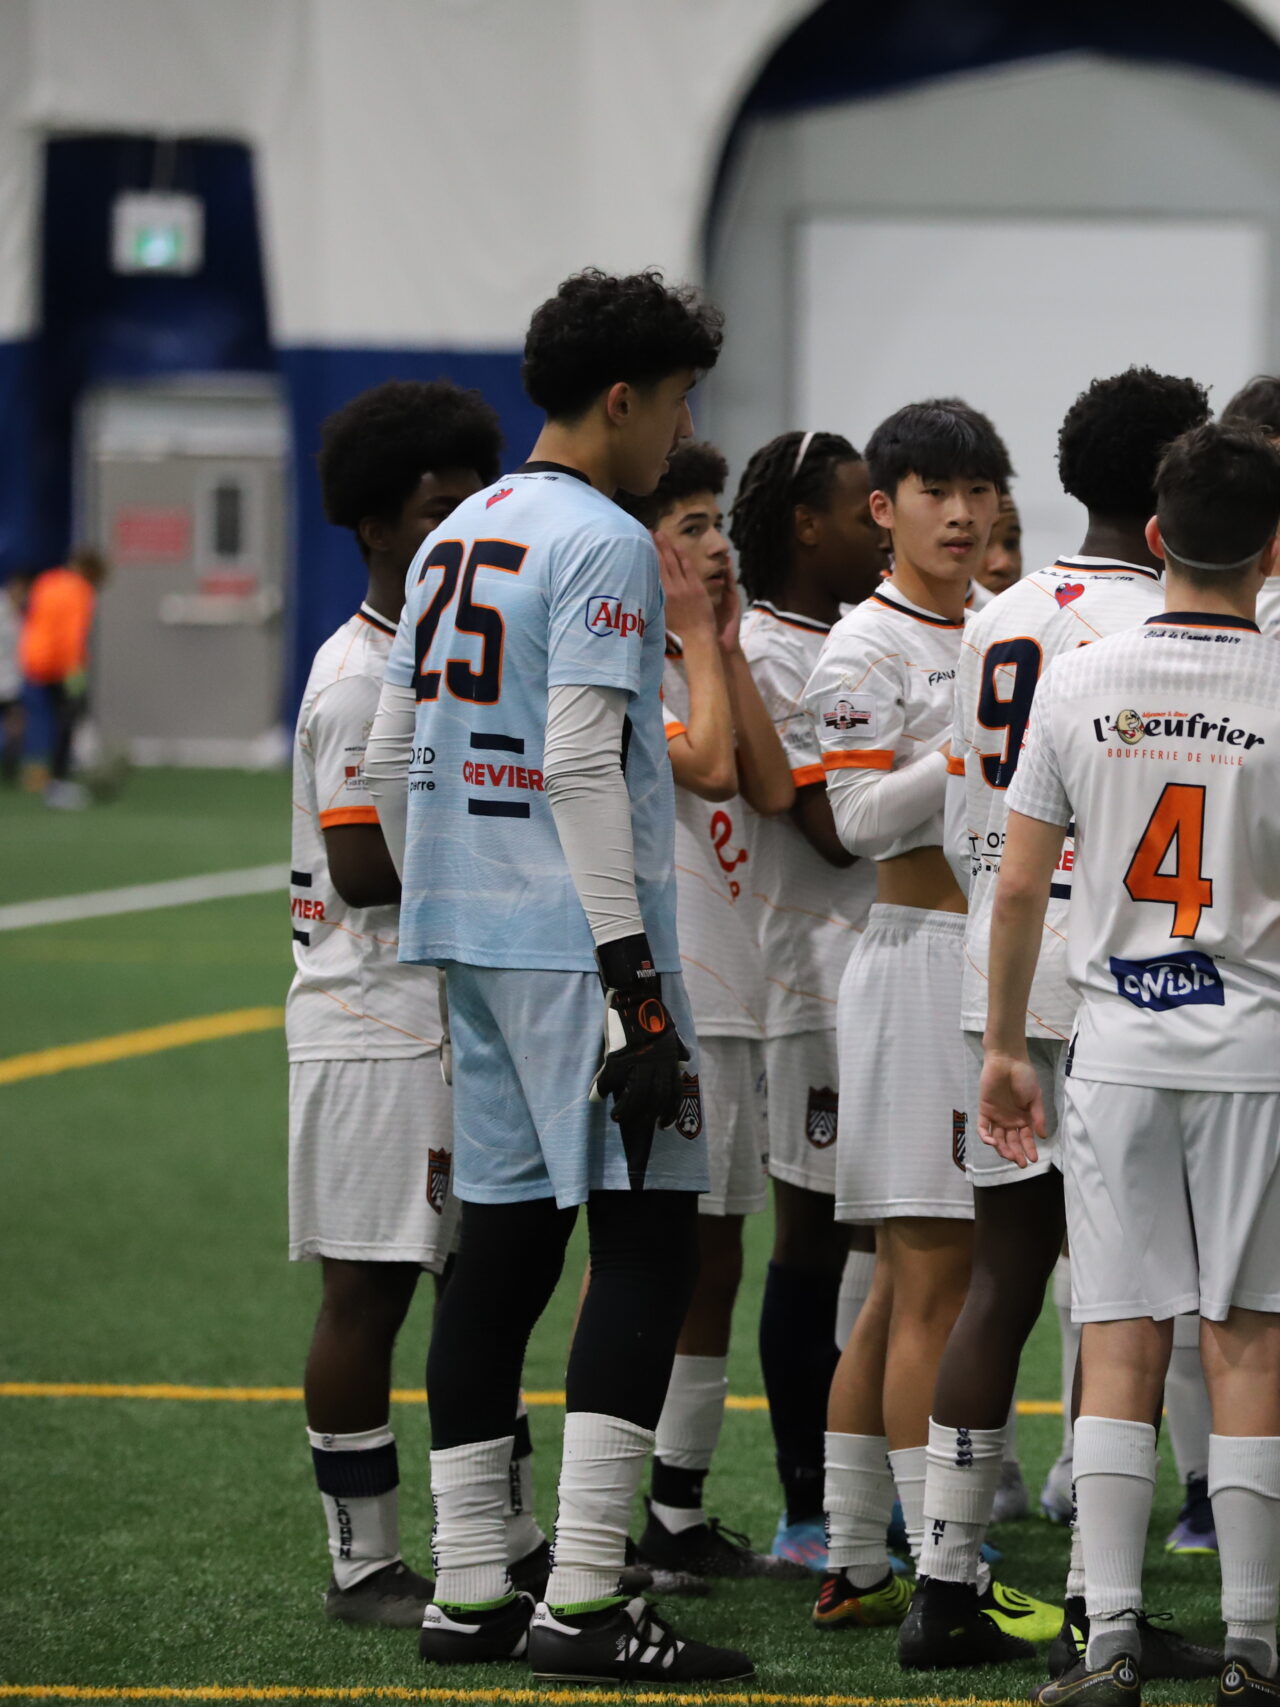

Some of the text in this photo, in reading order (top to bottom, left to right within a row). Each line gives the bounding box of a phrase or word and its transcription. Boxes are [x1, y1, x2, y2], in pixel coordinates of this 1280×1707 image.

[416, 538, 530, 706] 25
[463, 760, 545, 792] CREVIER
[1107, 748, 1243, 766] BOUFFERIE DE VILLE
[1123, 782, 1213, 939] 4
